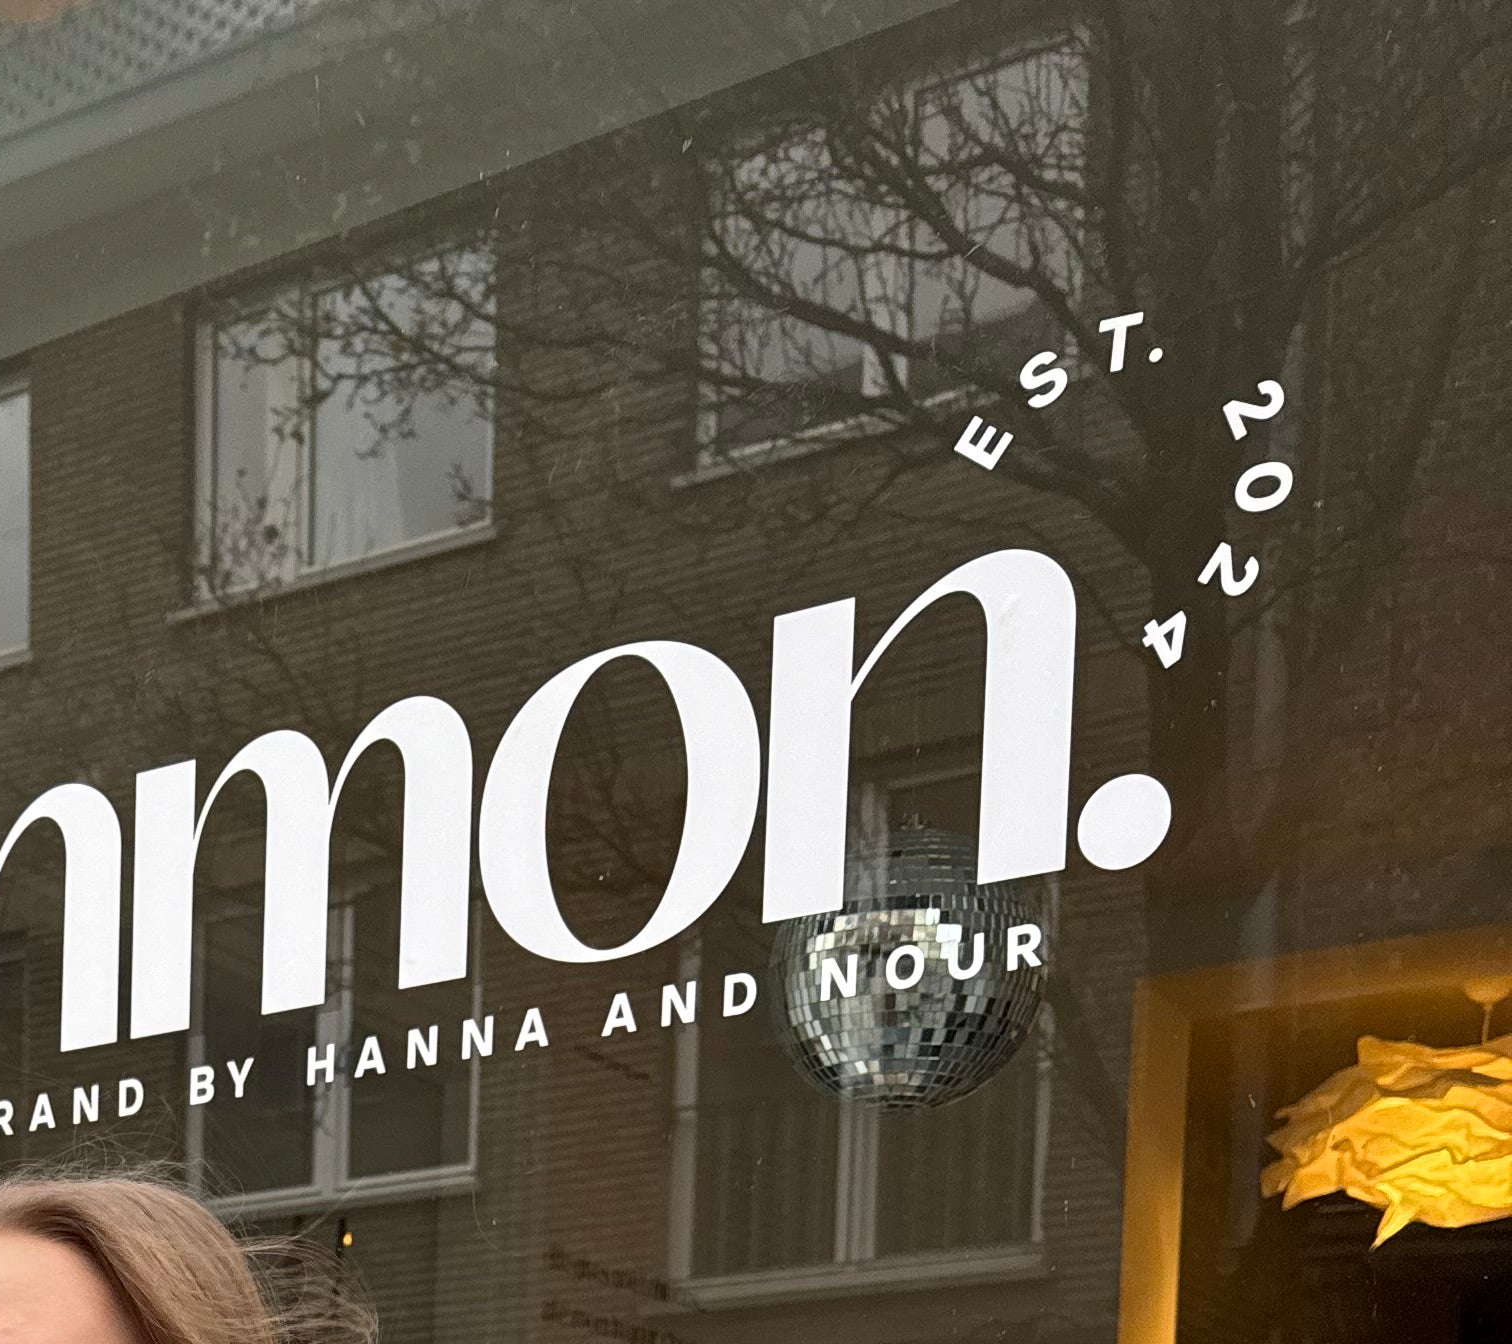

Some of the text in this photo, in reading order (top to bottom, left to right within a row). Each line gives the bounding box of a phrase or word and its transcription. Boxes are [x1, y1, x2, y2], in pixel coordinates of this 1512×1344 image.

[953, 310, 1295, 670] EST. 2024
[188, 1057, 256, 1107] BY
[306, 1006, 550, 1087] HANNA
[600, 971, 758, 1038] AND
[819, 922, 1044, 1003] NOUR
